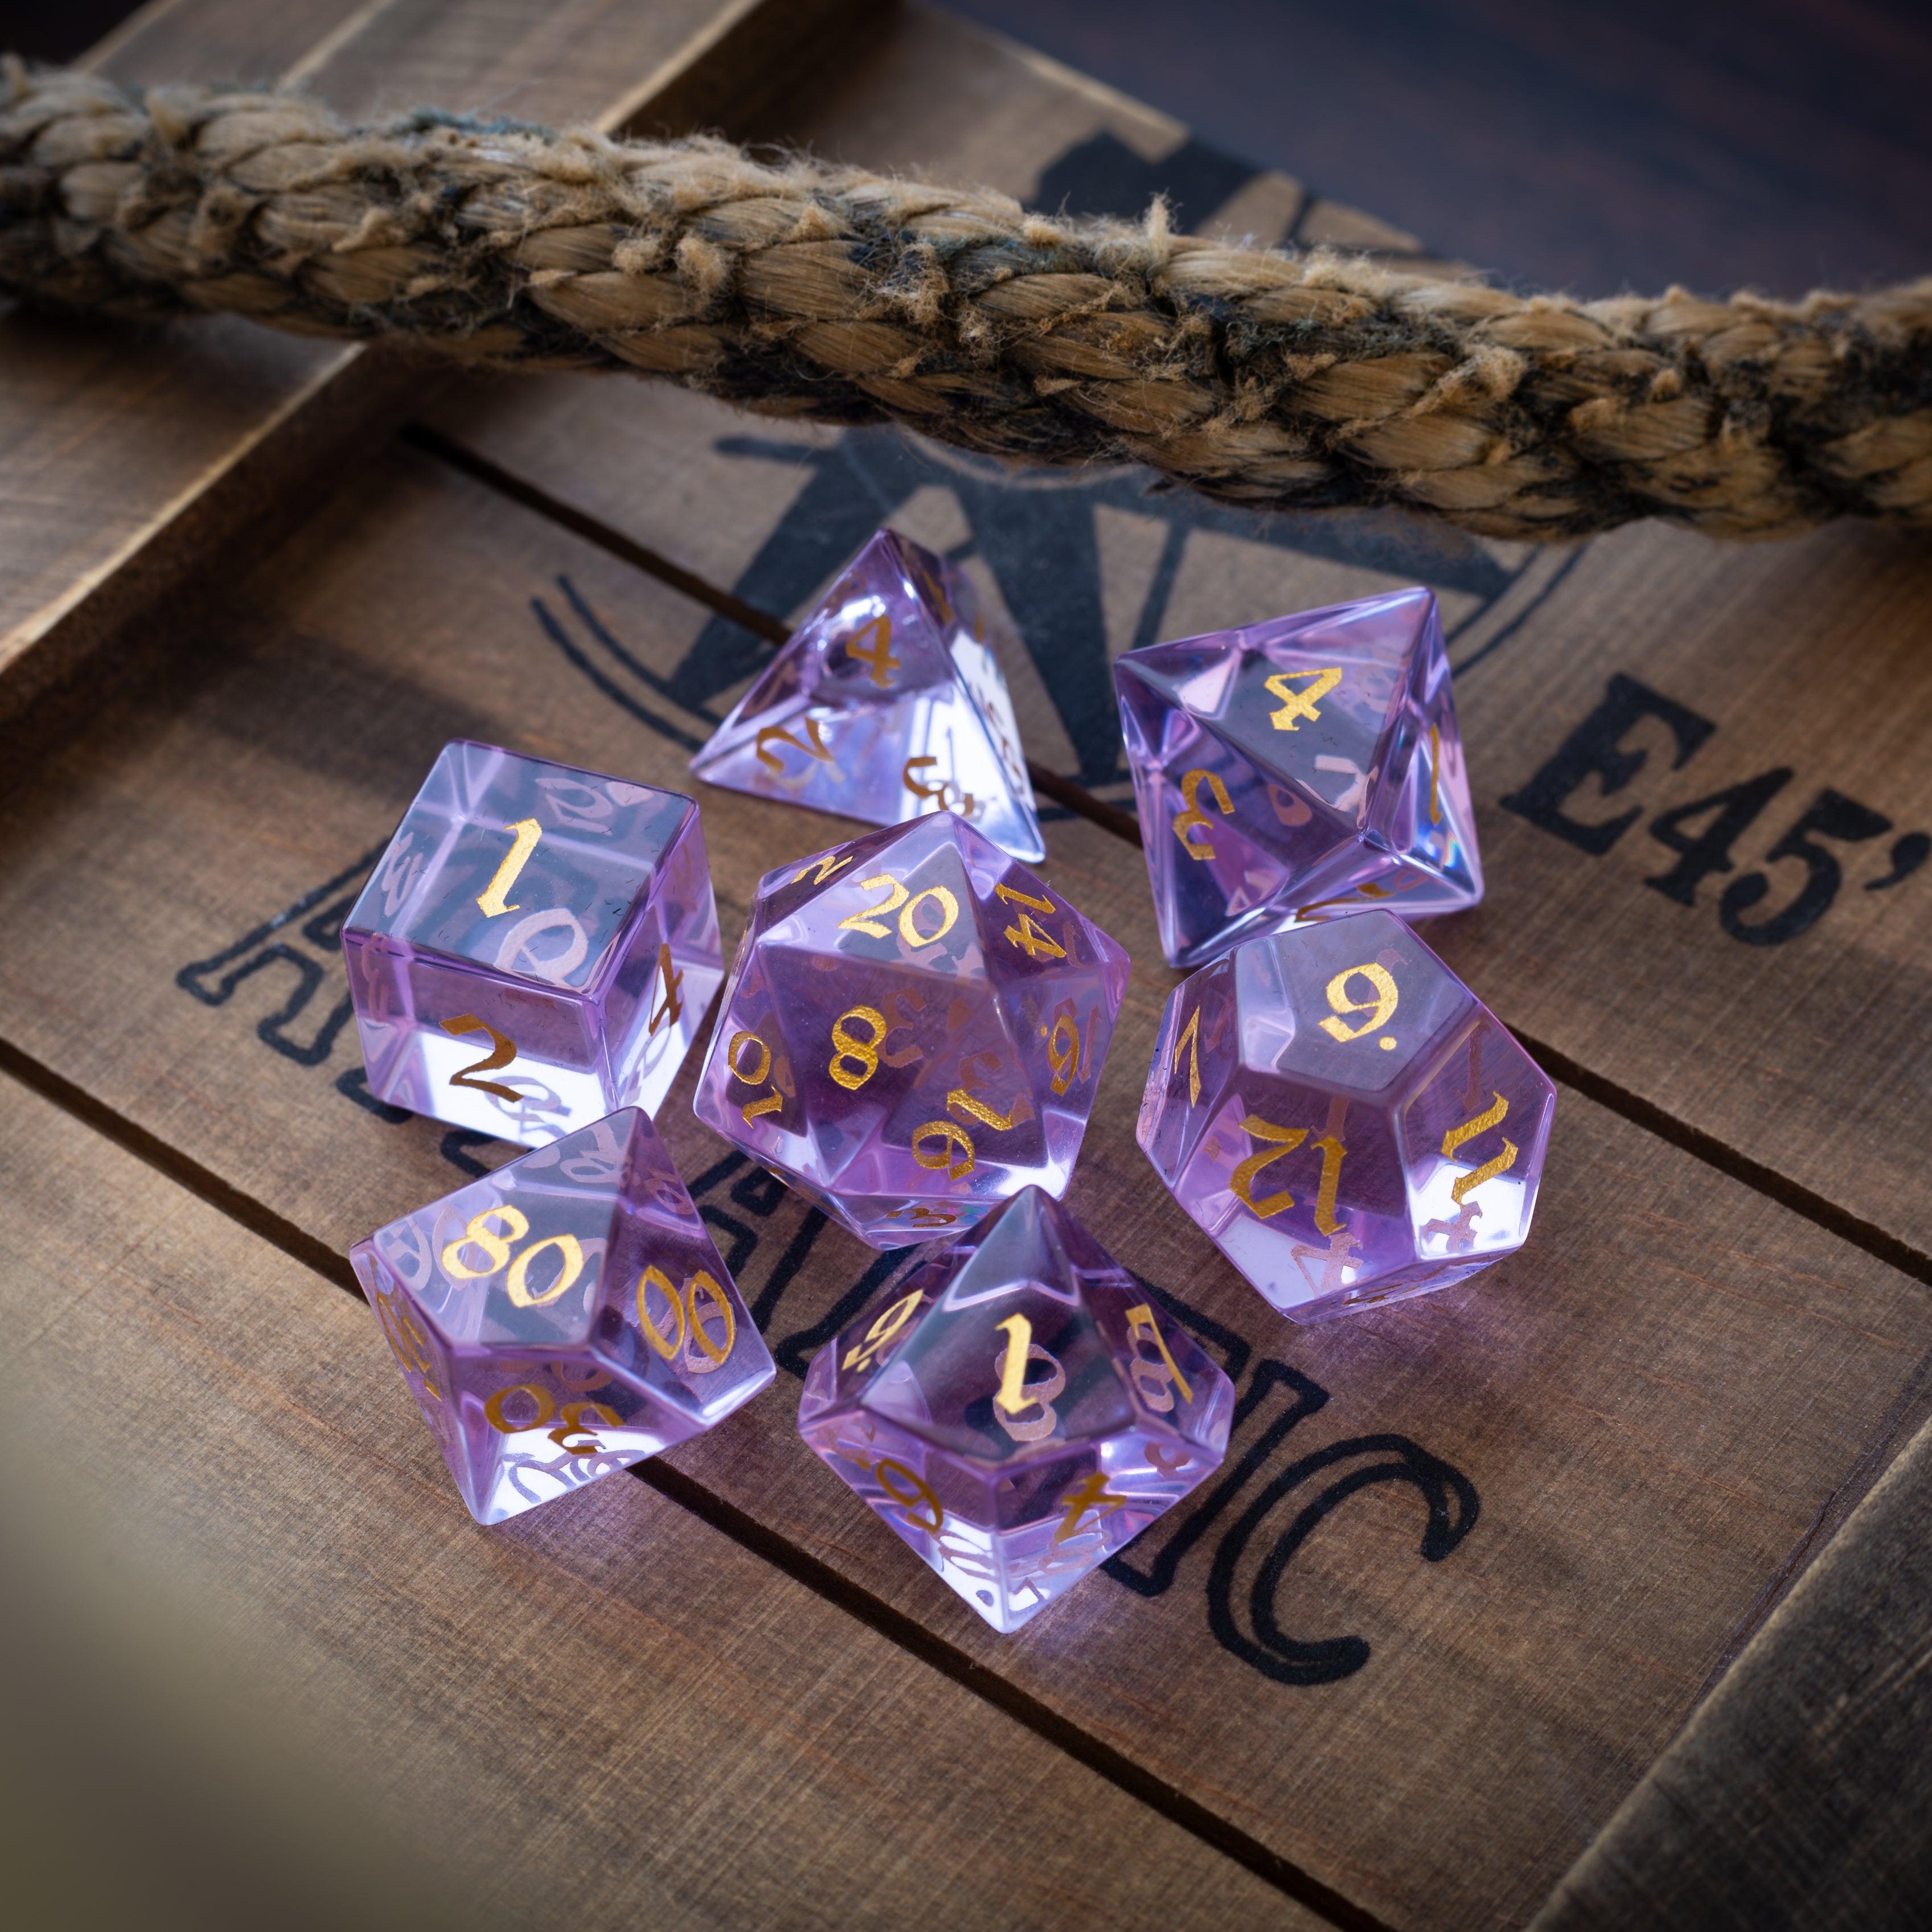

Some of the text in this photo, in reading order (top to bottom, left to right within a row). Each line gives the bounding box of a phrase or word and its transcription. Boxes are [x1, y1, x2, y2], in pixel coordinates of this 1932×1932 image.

[846, 614, 901, 689] 4
[756, 716, 834, 773] 2
[1264, 666, 1343, 731] 4
[1172, 768, 1236, 861] 3
[475, 818, 542, 918] 1
[836, 873, 959, 947] 20
[994, 882, 1067, 958] 14
[440, 1014, 524, 1103] 2
[728, 1031, 784, 1129] 10
[829, 1005, 887, 1090] 8
[912, 1088, 1014, 1182] 16
[1228, 1114, 1348, 1236] 12
[1441, 1090, 1519, 1208] 11
[441, 1205, 584, 1308] 80
[635, 1265, 736, 1366] 00
[995, 1312, 1039, 1415] 1
